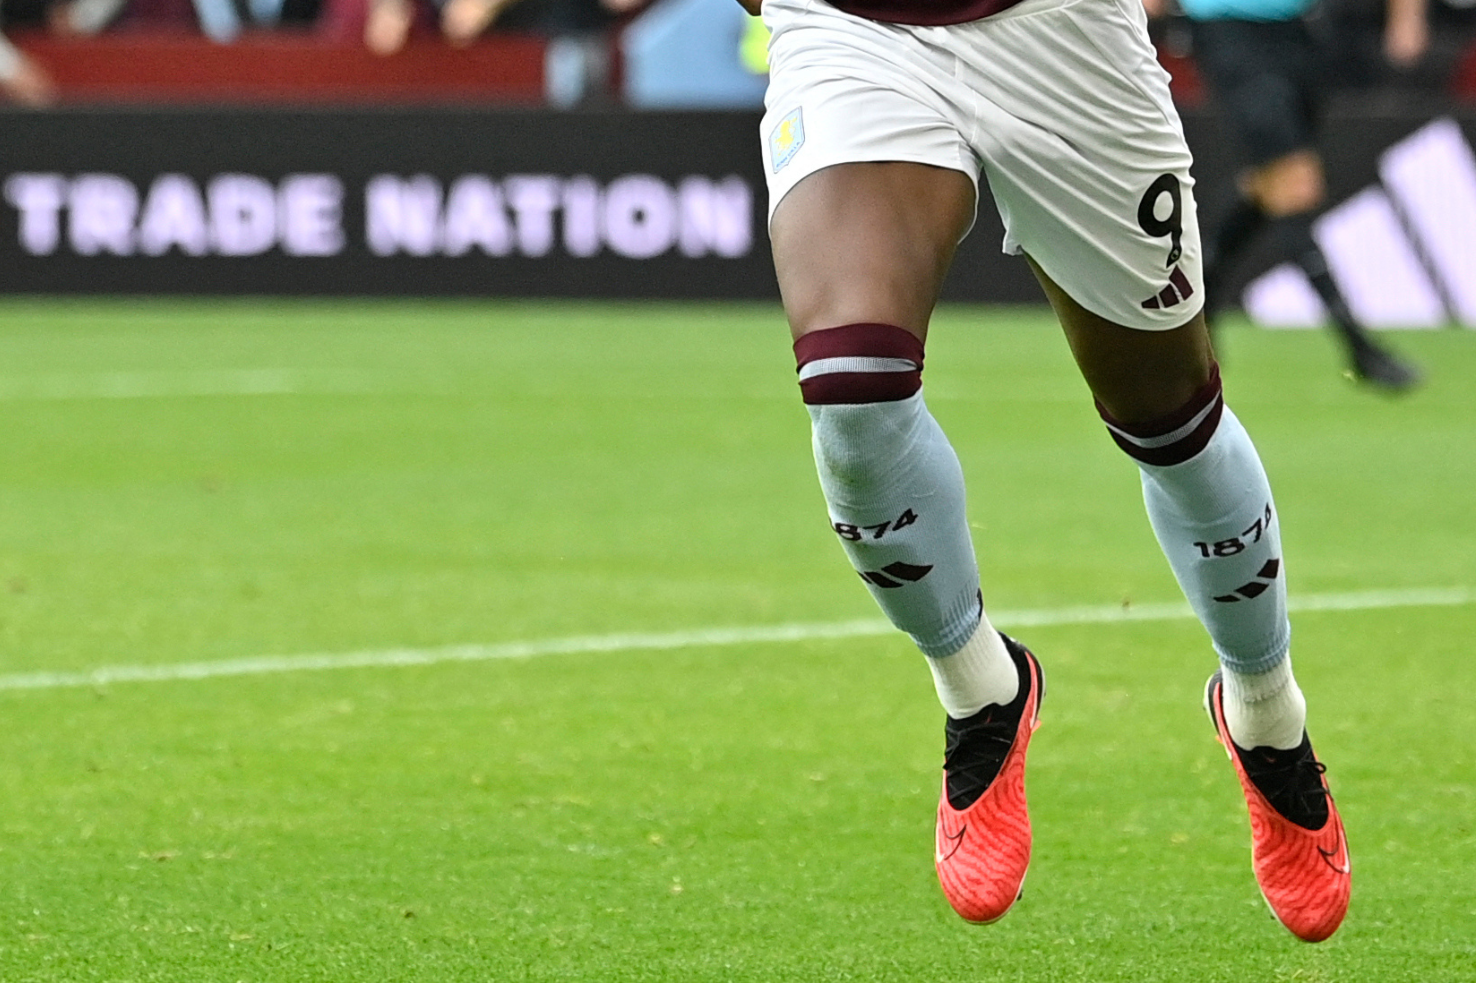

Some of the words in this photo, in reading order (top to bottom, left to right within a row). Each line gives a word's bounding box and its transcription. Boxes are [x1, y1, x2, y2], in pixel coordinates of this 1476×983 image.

[3, 173, 345, 258] TRADE
[363, 173, 754, 259] NATION
[1137, 172, 1184, 270] 9
[829, 507, 919, 542] 874
